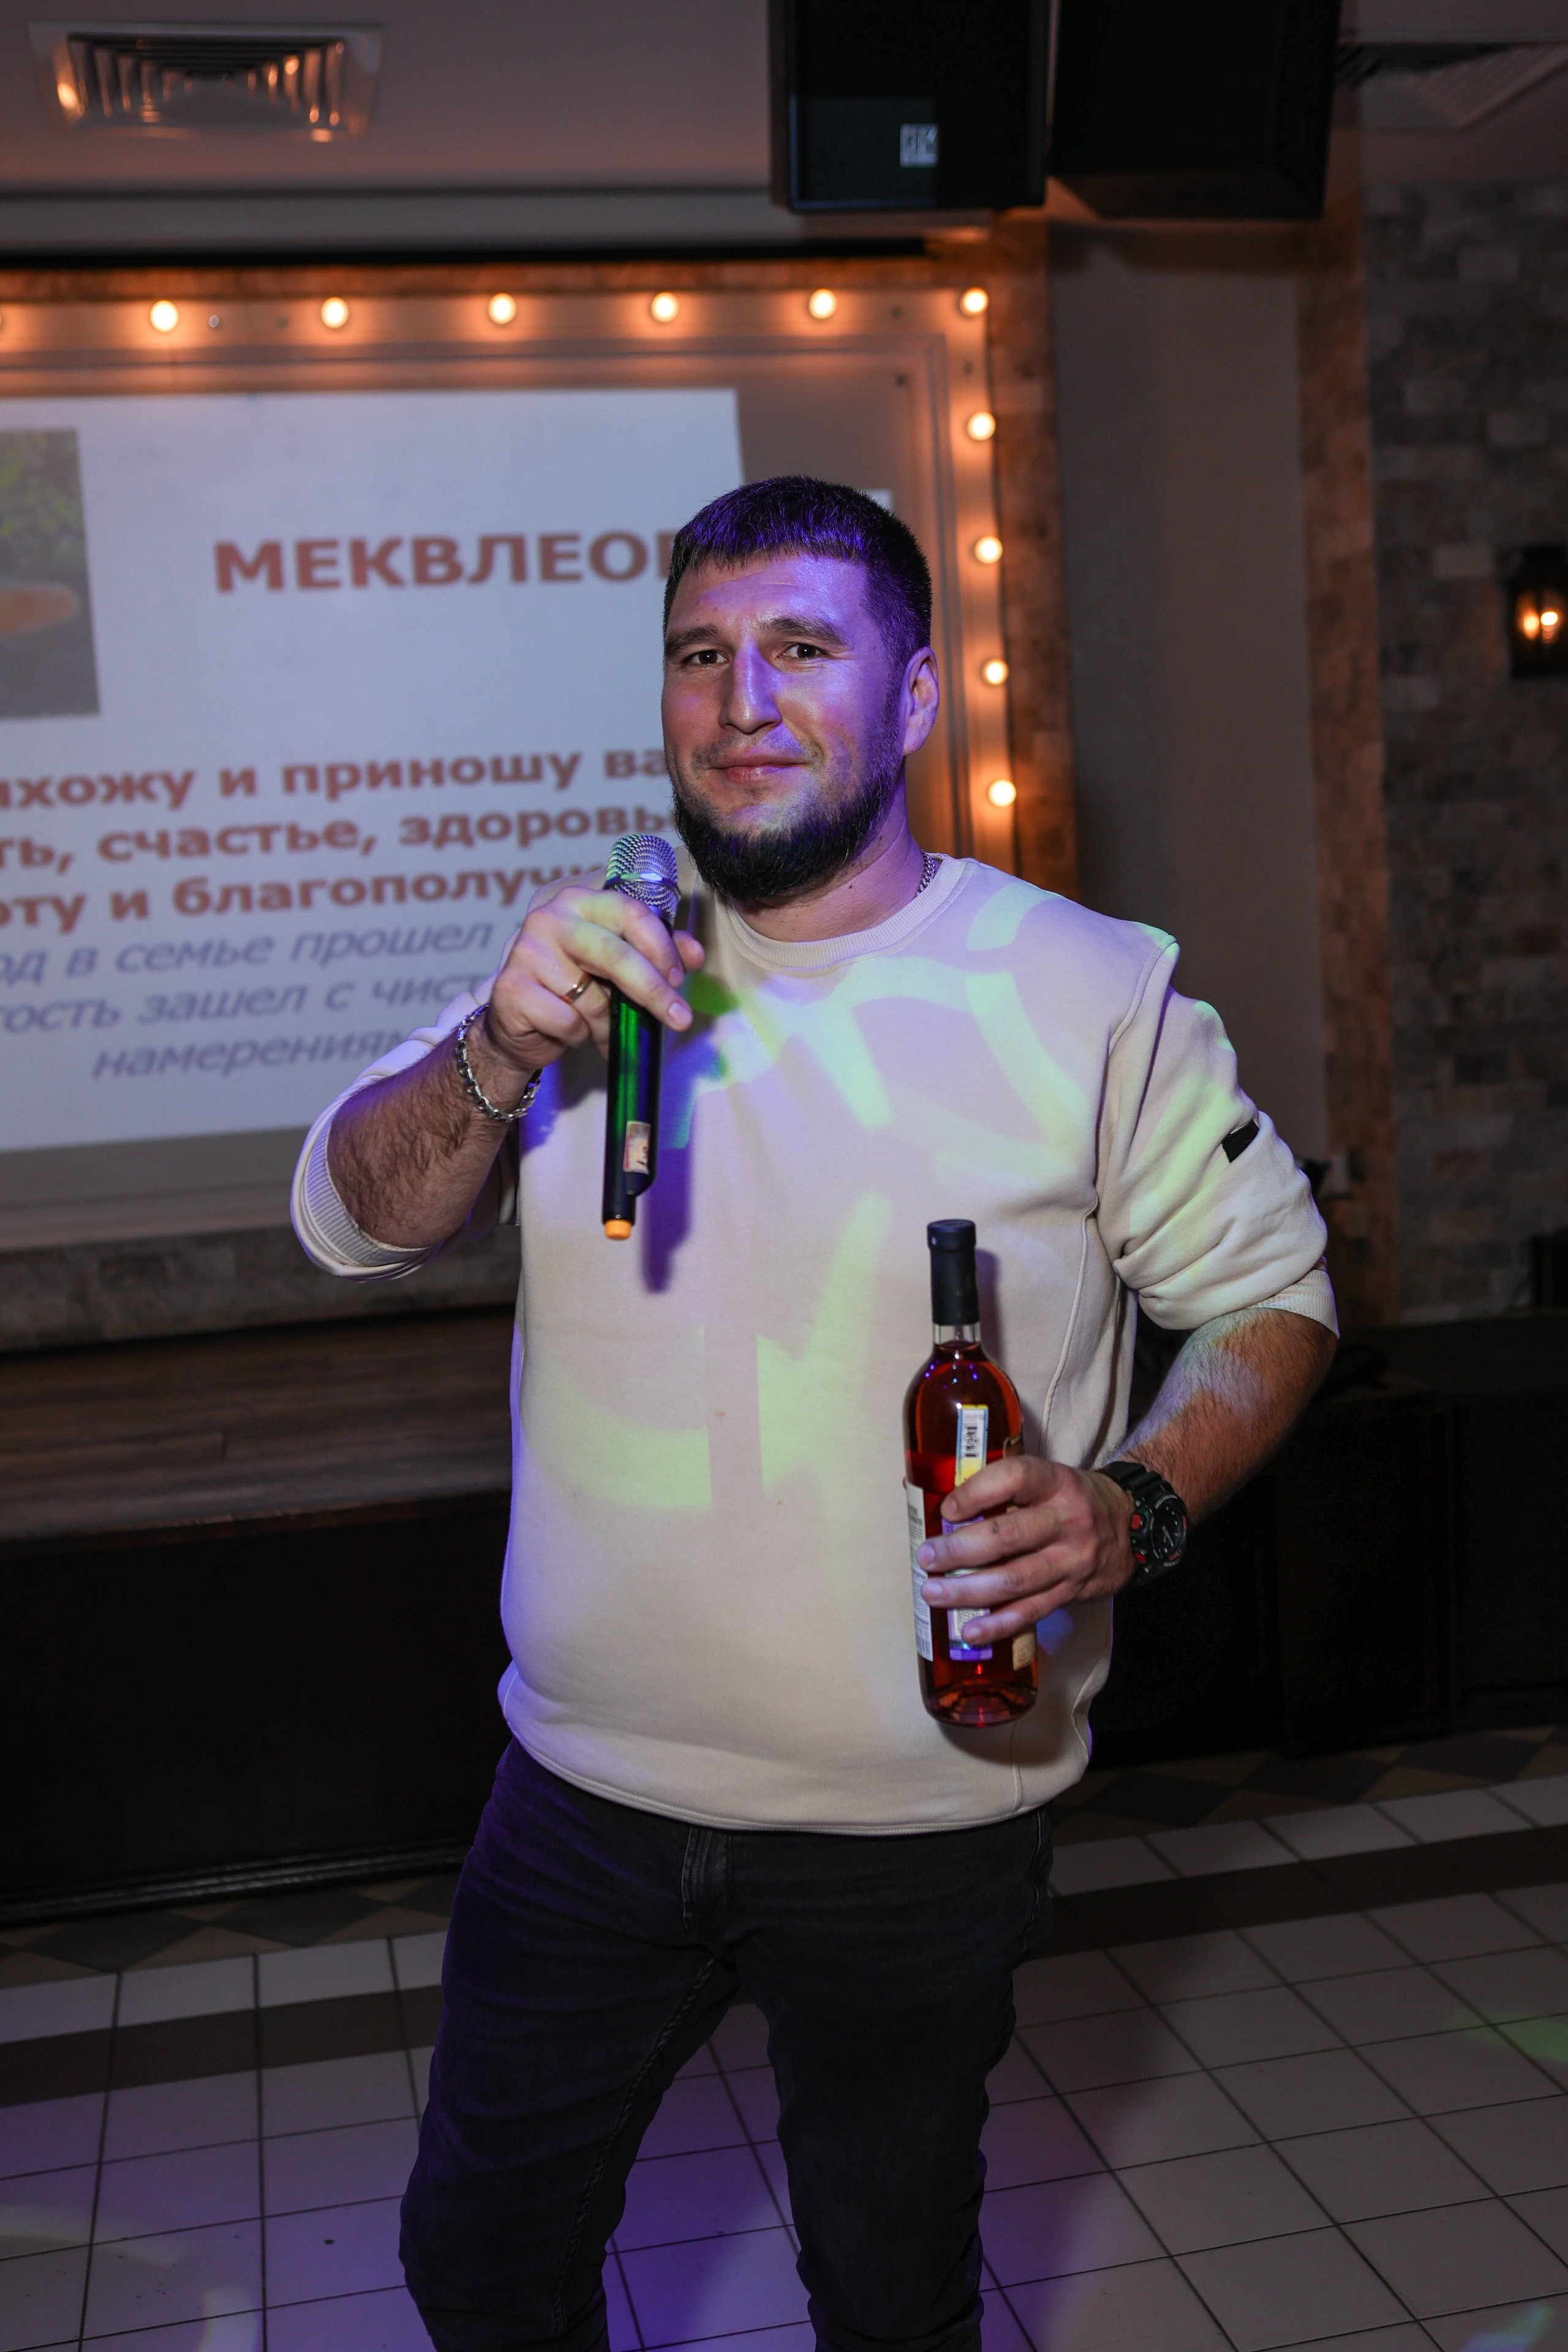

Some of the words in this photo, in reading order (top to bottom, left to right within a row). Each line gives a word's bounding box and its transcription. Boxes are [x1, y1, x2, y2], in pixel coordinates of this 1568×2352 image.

[0, 771, 195, 810] хожу
[219, 768, 257, 798] и
[282, 752, 581, 802] приношу
[97, 821, 377, 862] счастье,
[401, 804, 676, 850] здоровь
[111, 891, 149, 921] и
[173, 864, 603, 916] благополуч
[65, 948, 98, 978] в
[115, 937, 275, 974] семье
[290, 922, 495, 969] прошел
[137, 985, 309, 1025] зашел
[324, 981, 355, 1011] с
